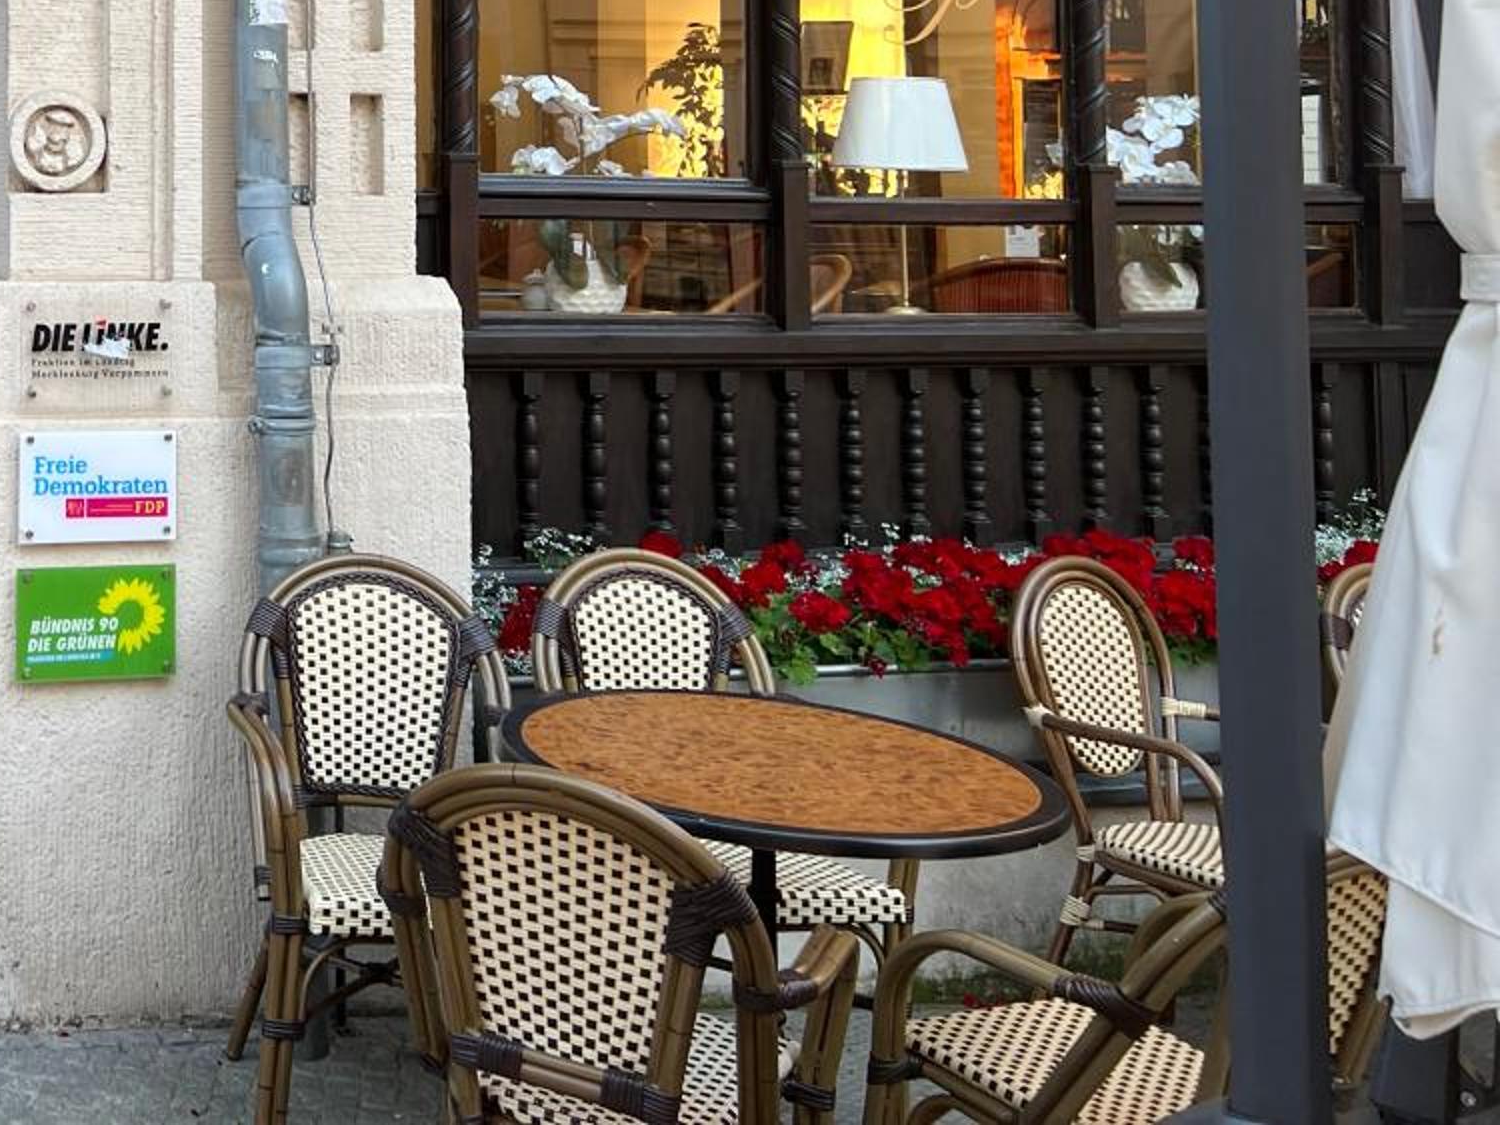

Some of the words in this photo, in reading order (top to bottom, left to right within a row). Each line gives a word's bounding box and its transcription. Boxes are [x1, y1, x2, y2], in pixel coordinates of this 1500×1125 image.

[32, 322, 77, 352] DIE
[34, 456, 88, 475] Freie
[34, 475, 168, 496] Demokraten
[134, 500, 165, 514] FDP
[30, 616, 94, 635] BÜNDNIS
[99, 617, 119, 632] 90
[27, 637, 52, 652] DIE
[56, 631, 117, 652] GRÜNEN
